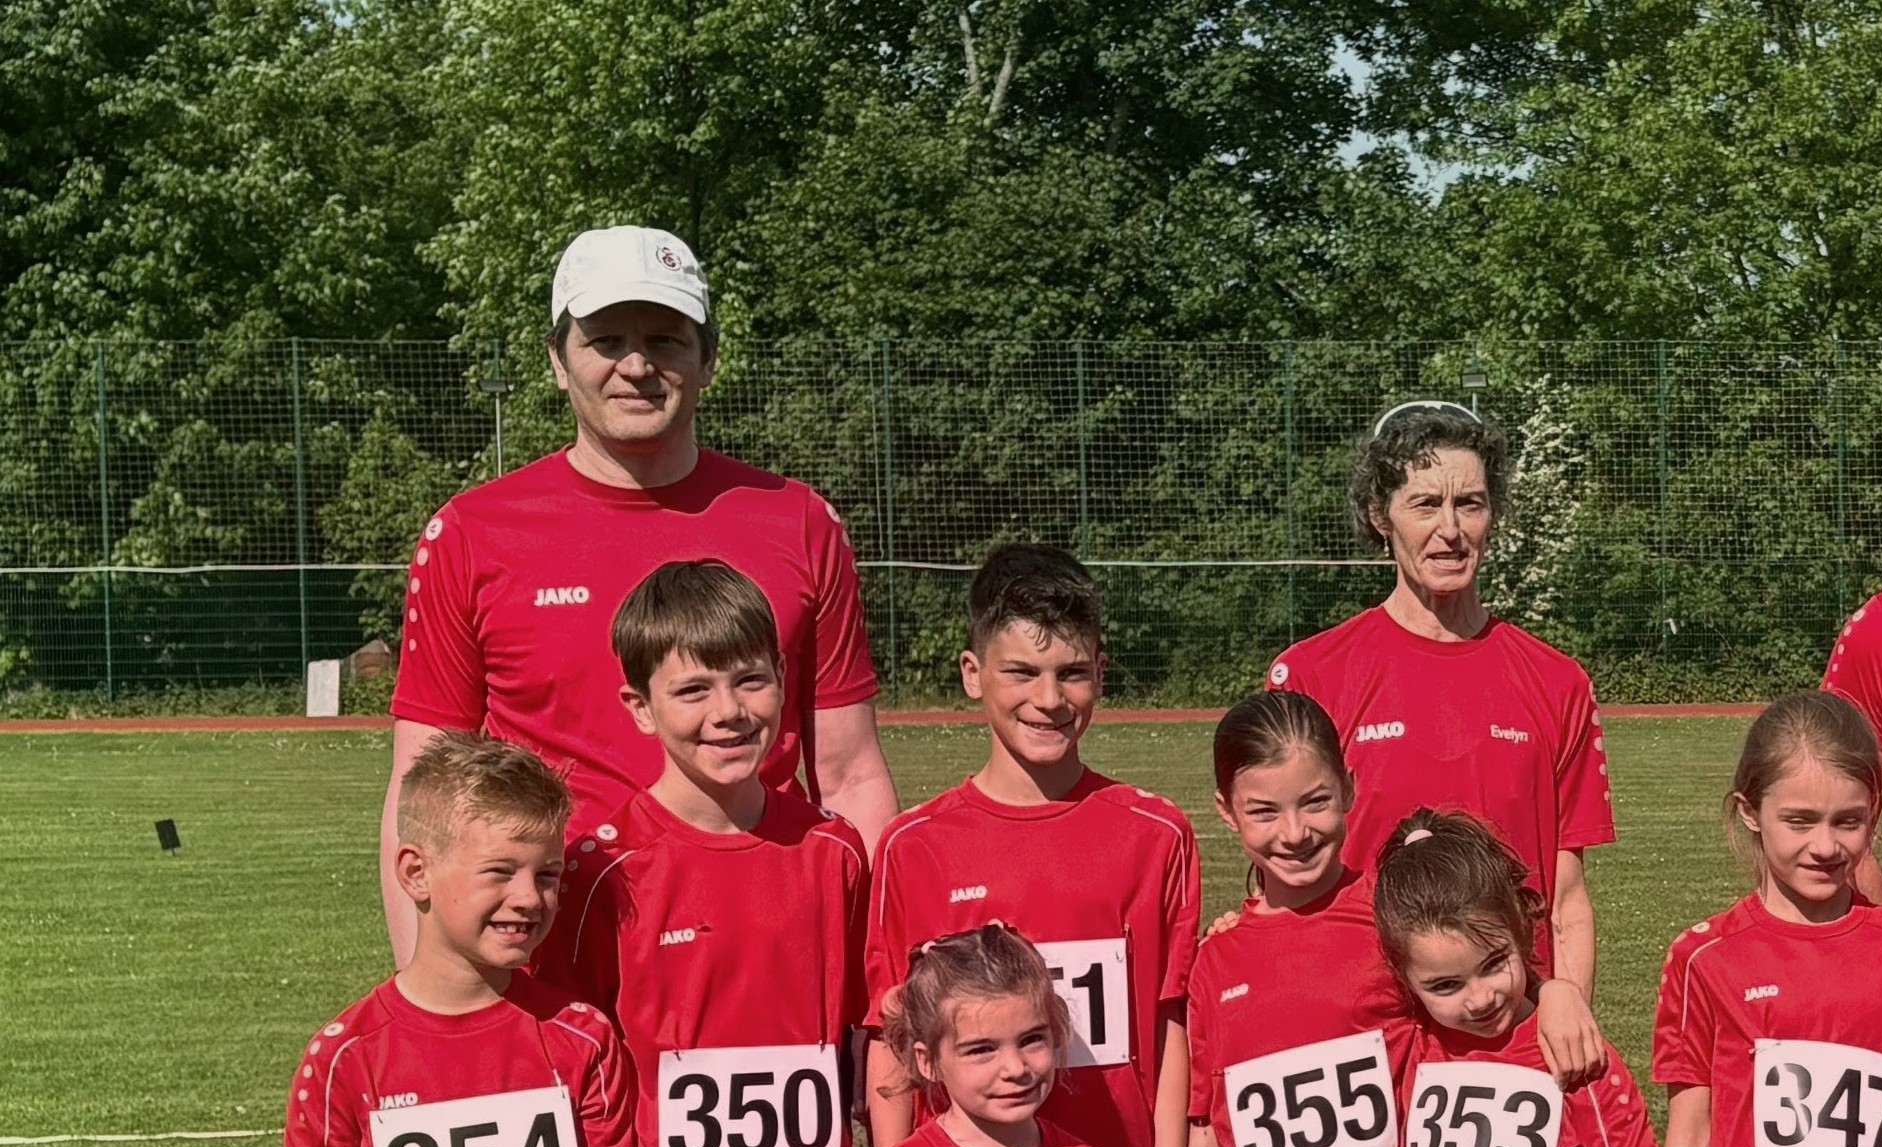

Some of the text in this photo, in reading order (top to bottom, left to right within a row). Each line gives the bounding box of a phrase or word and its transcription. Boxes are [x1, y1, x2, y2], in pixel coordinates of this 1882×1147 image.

[534, 586, 590, 606] JAKO
[1356, 721, 1405, 742] JAKO
[1490, 724, 1528, 744] Evelyn
[950, 886, 987, 903] JAKO
[660, 928, 696, 946] JAKO
[1220, 983, 1250, 1003] JAKO
[1745, 985, 1779, 1001] JAKO
